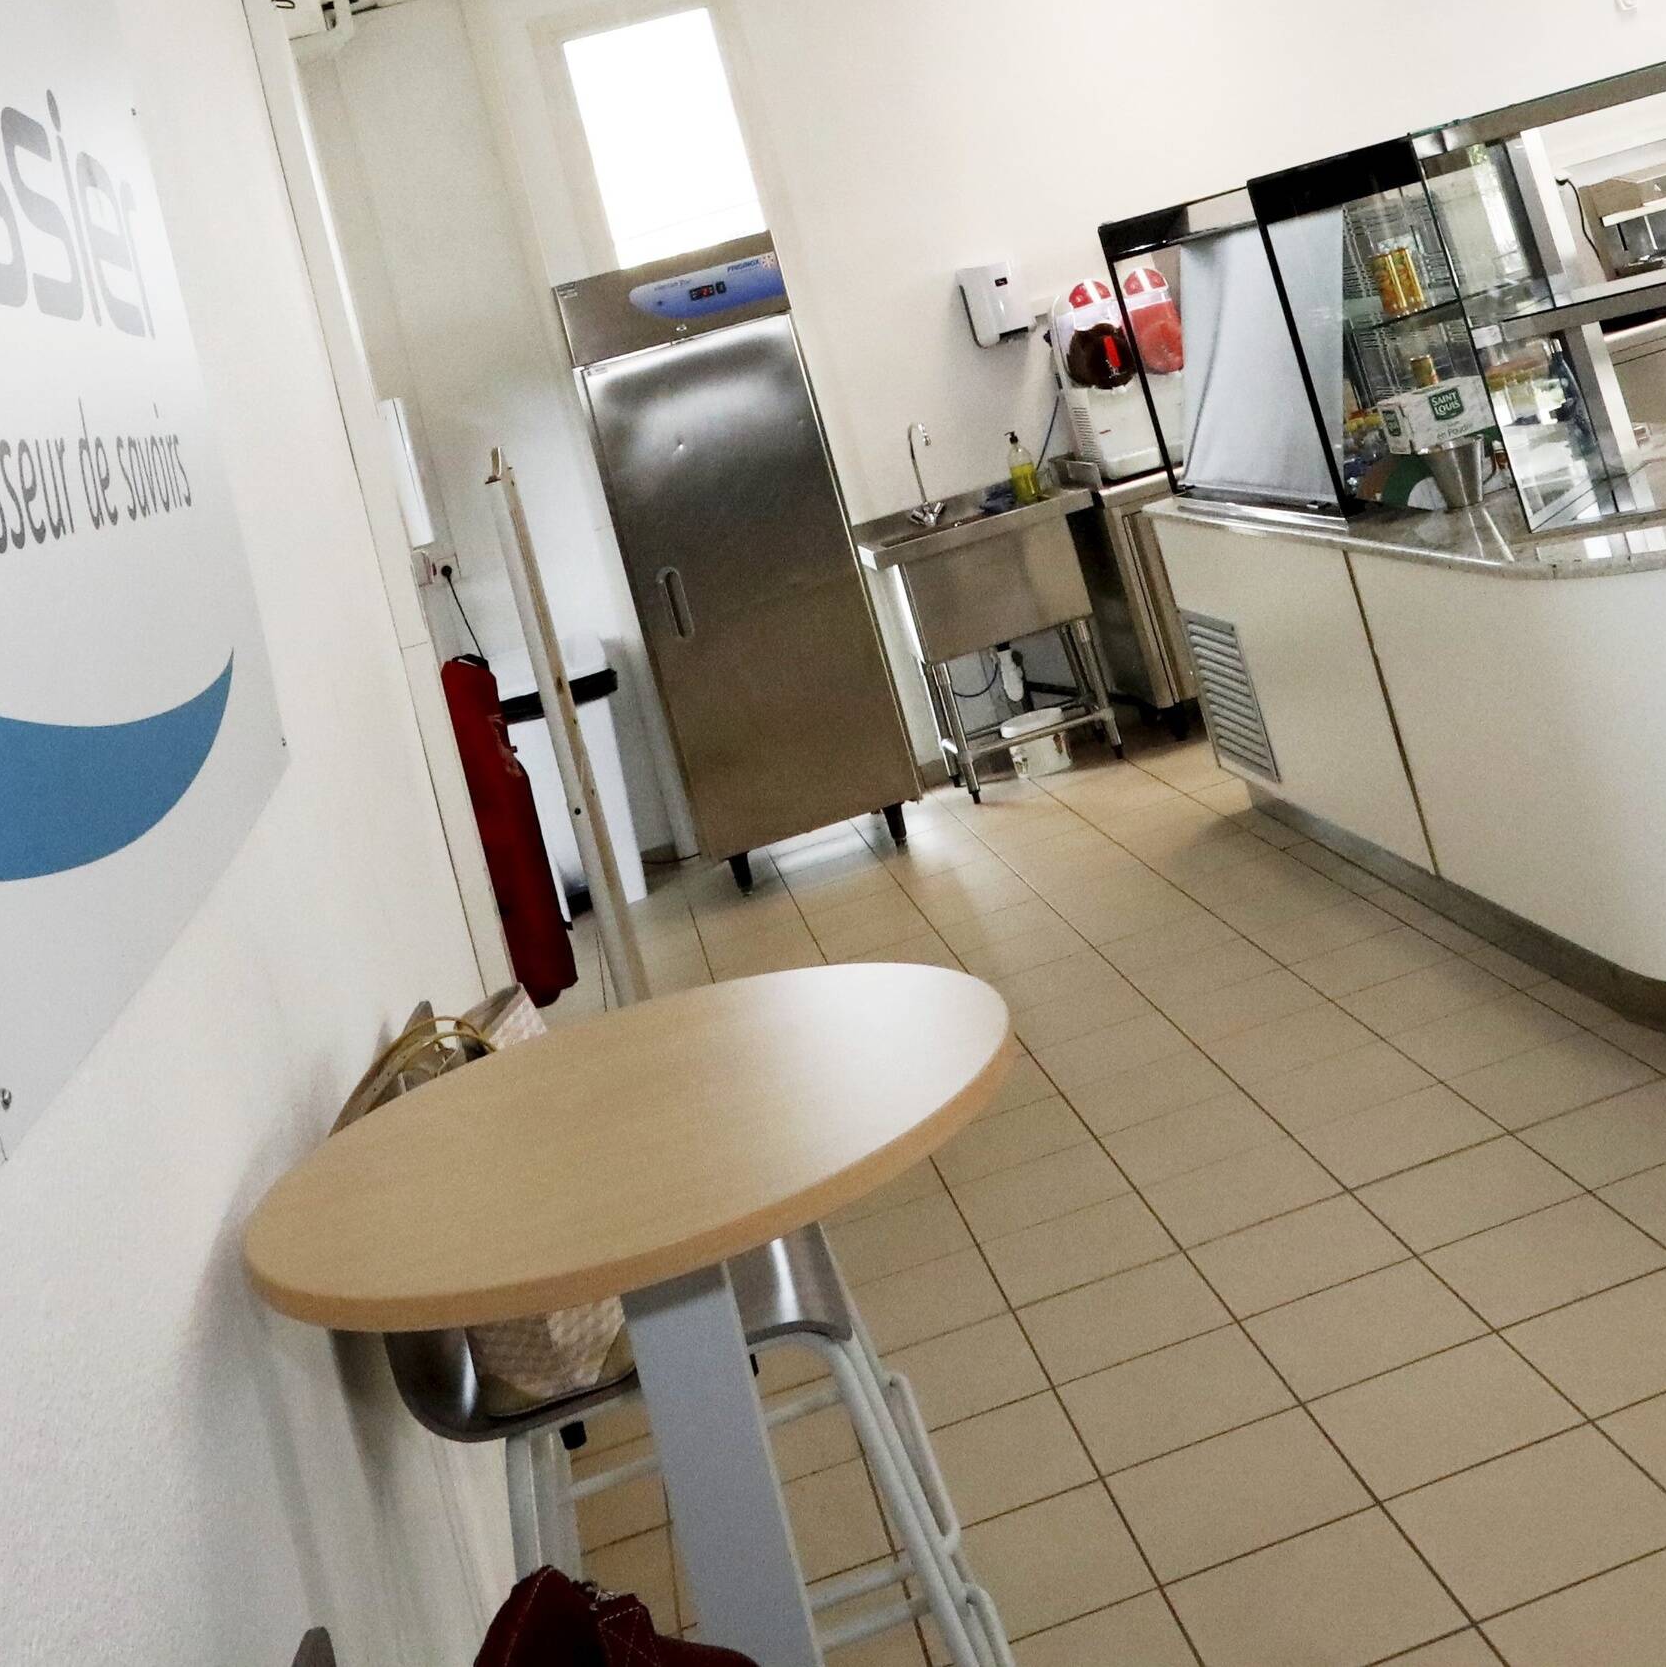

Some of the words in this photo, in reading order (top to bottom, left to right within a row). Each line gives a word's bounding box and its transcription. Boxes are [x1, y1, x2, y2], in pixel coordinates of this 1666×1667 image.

[1431, 392, 1457, 407] SAINT
[1434, 399, 1461, 416] LOUIS
[77, 395, 119, 531] de
[116, 402, 192, 522] savoirs
